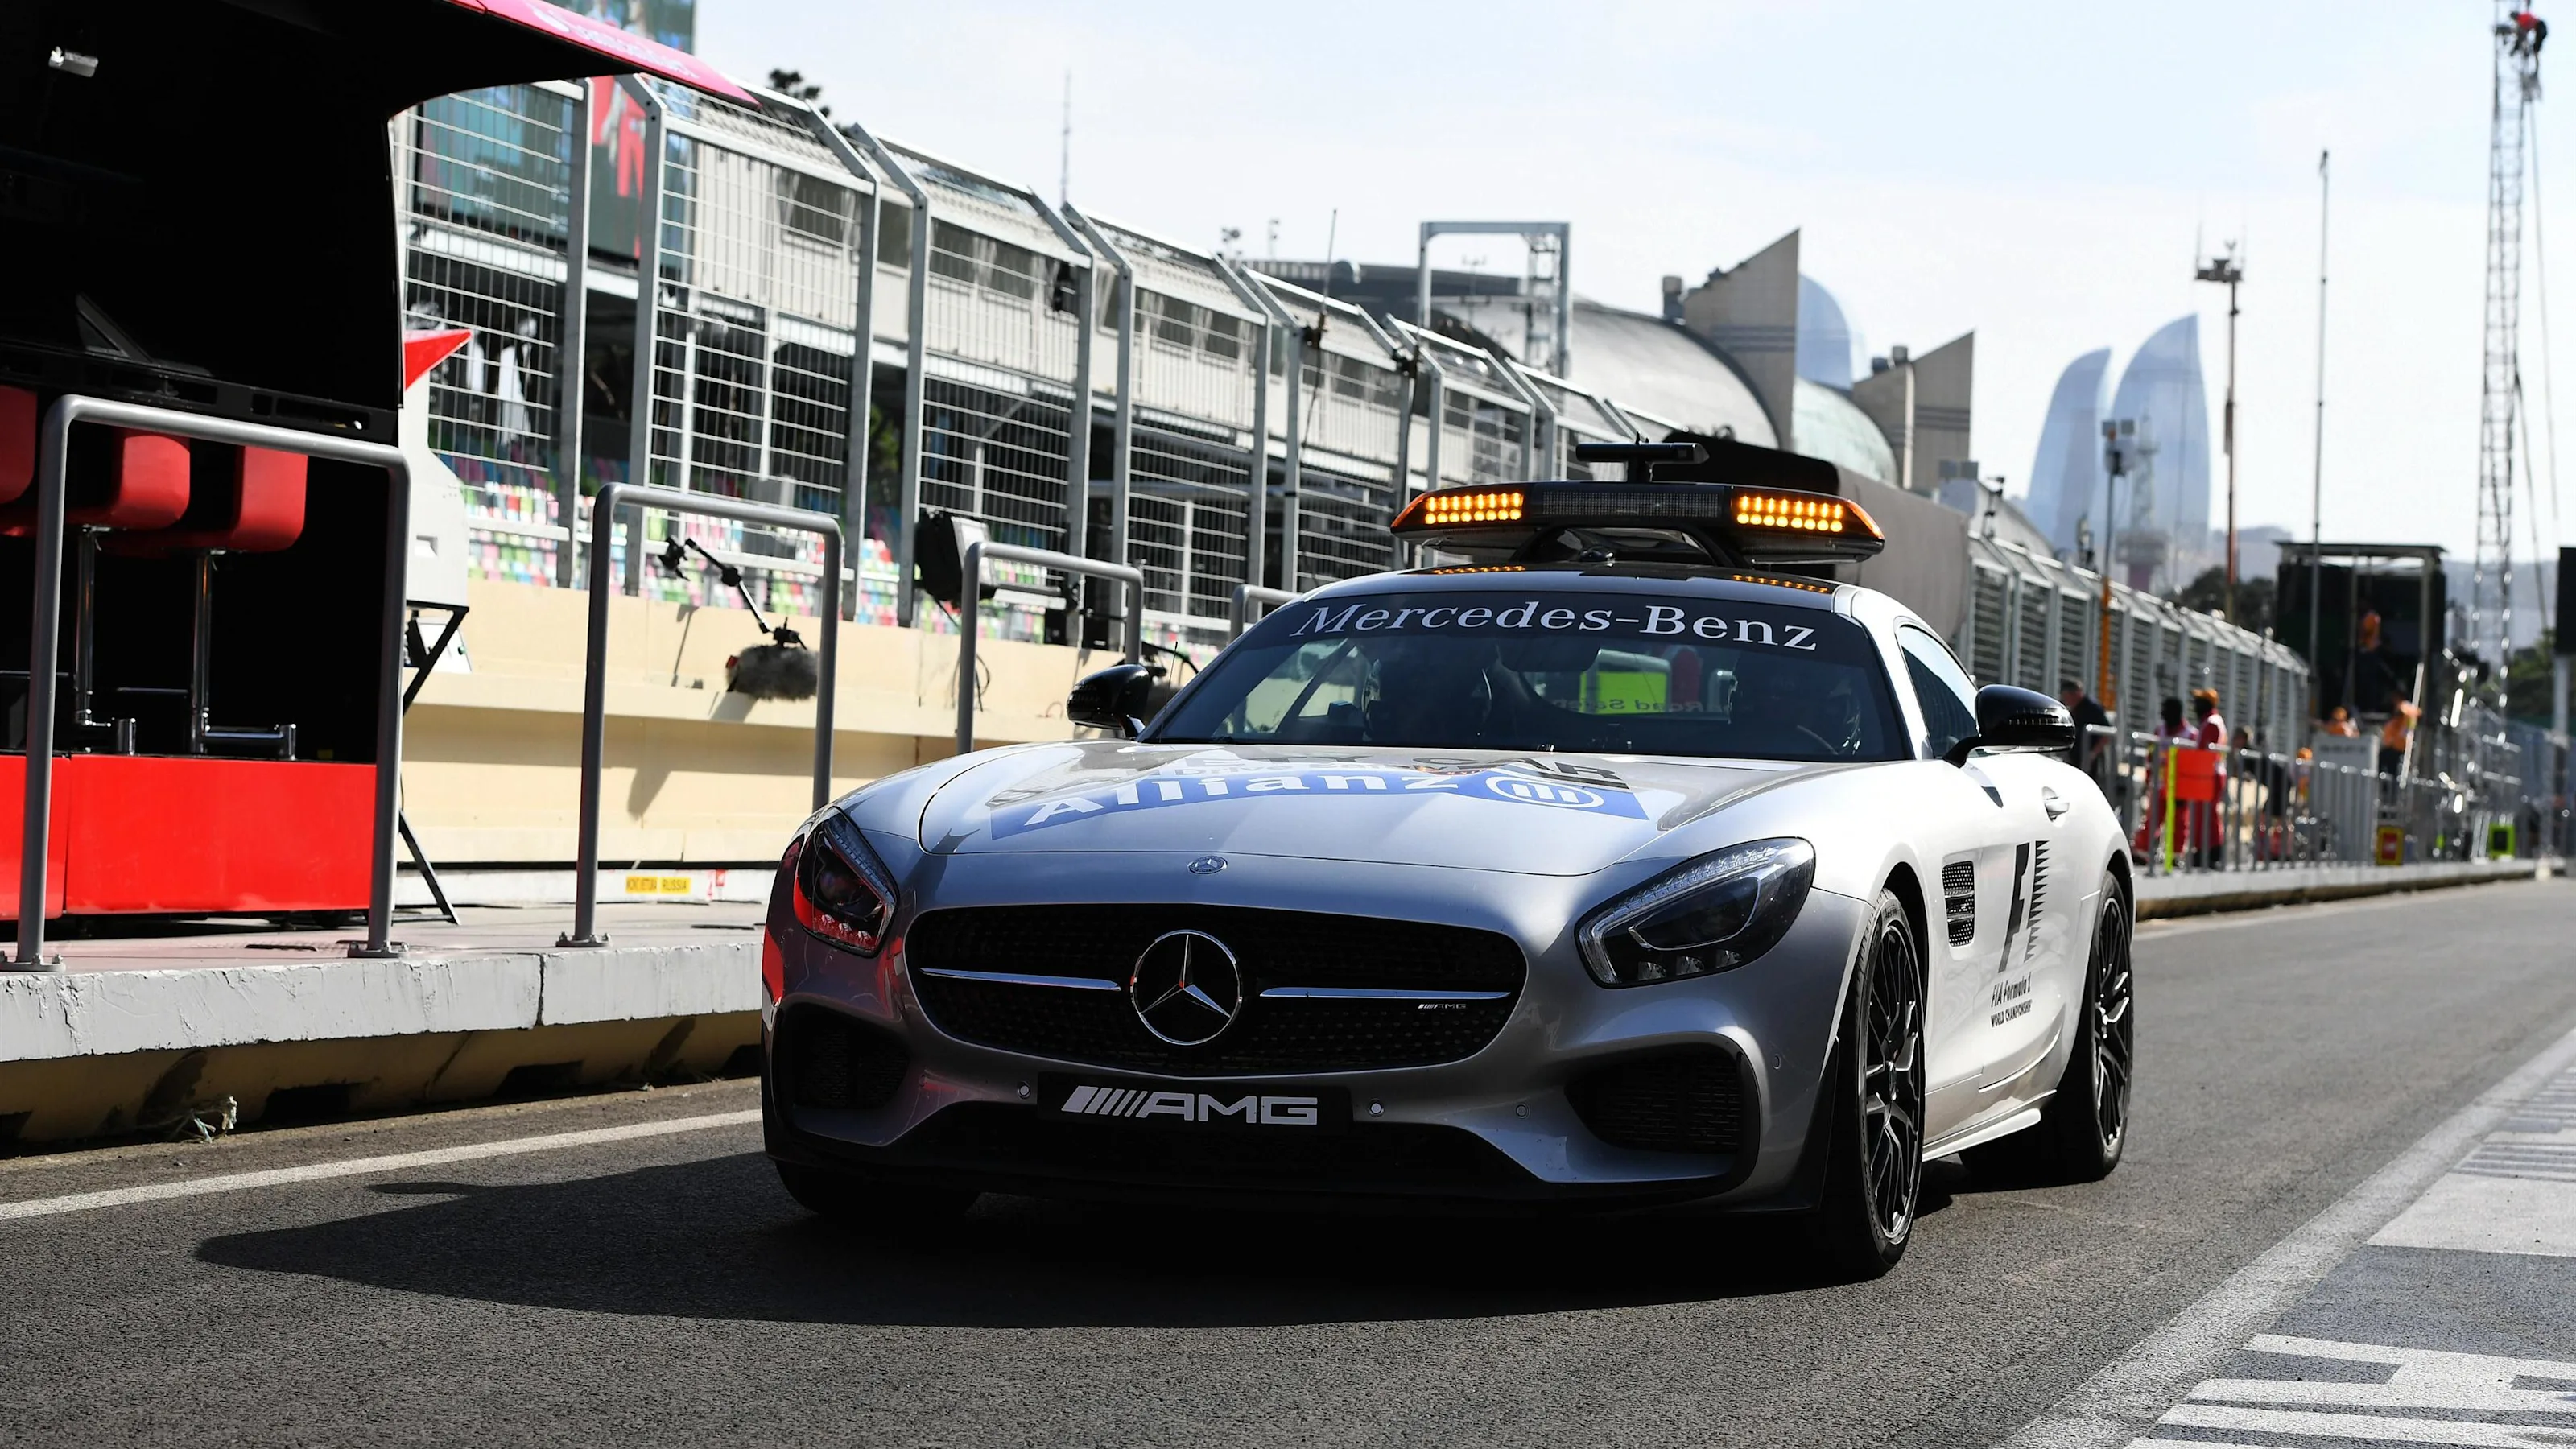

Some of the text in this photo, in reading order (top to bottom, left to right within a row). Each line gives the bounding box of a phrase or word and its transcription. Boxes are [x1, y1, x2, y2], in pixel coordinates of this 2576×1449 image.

[1290, 601, 1818, 650] Mercedes-Benz
[1024, 774, 1459, 826] Allianz
[1991, 982, 2004, 1008] FIA
